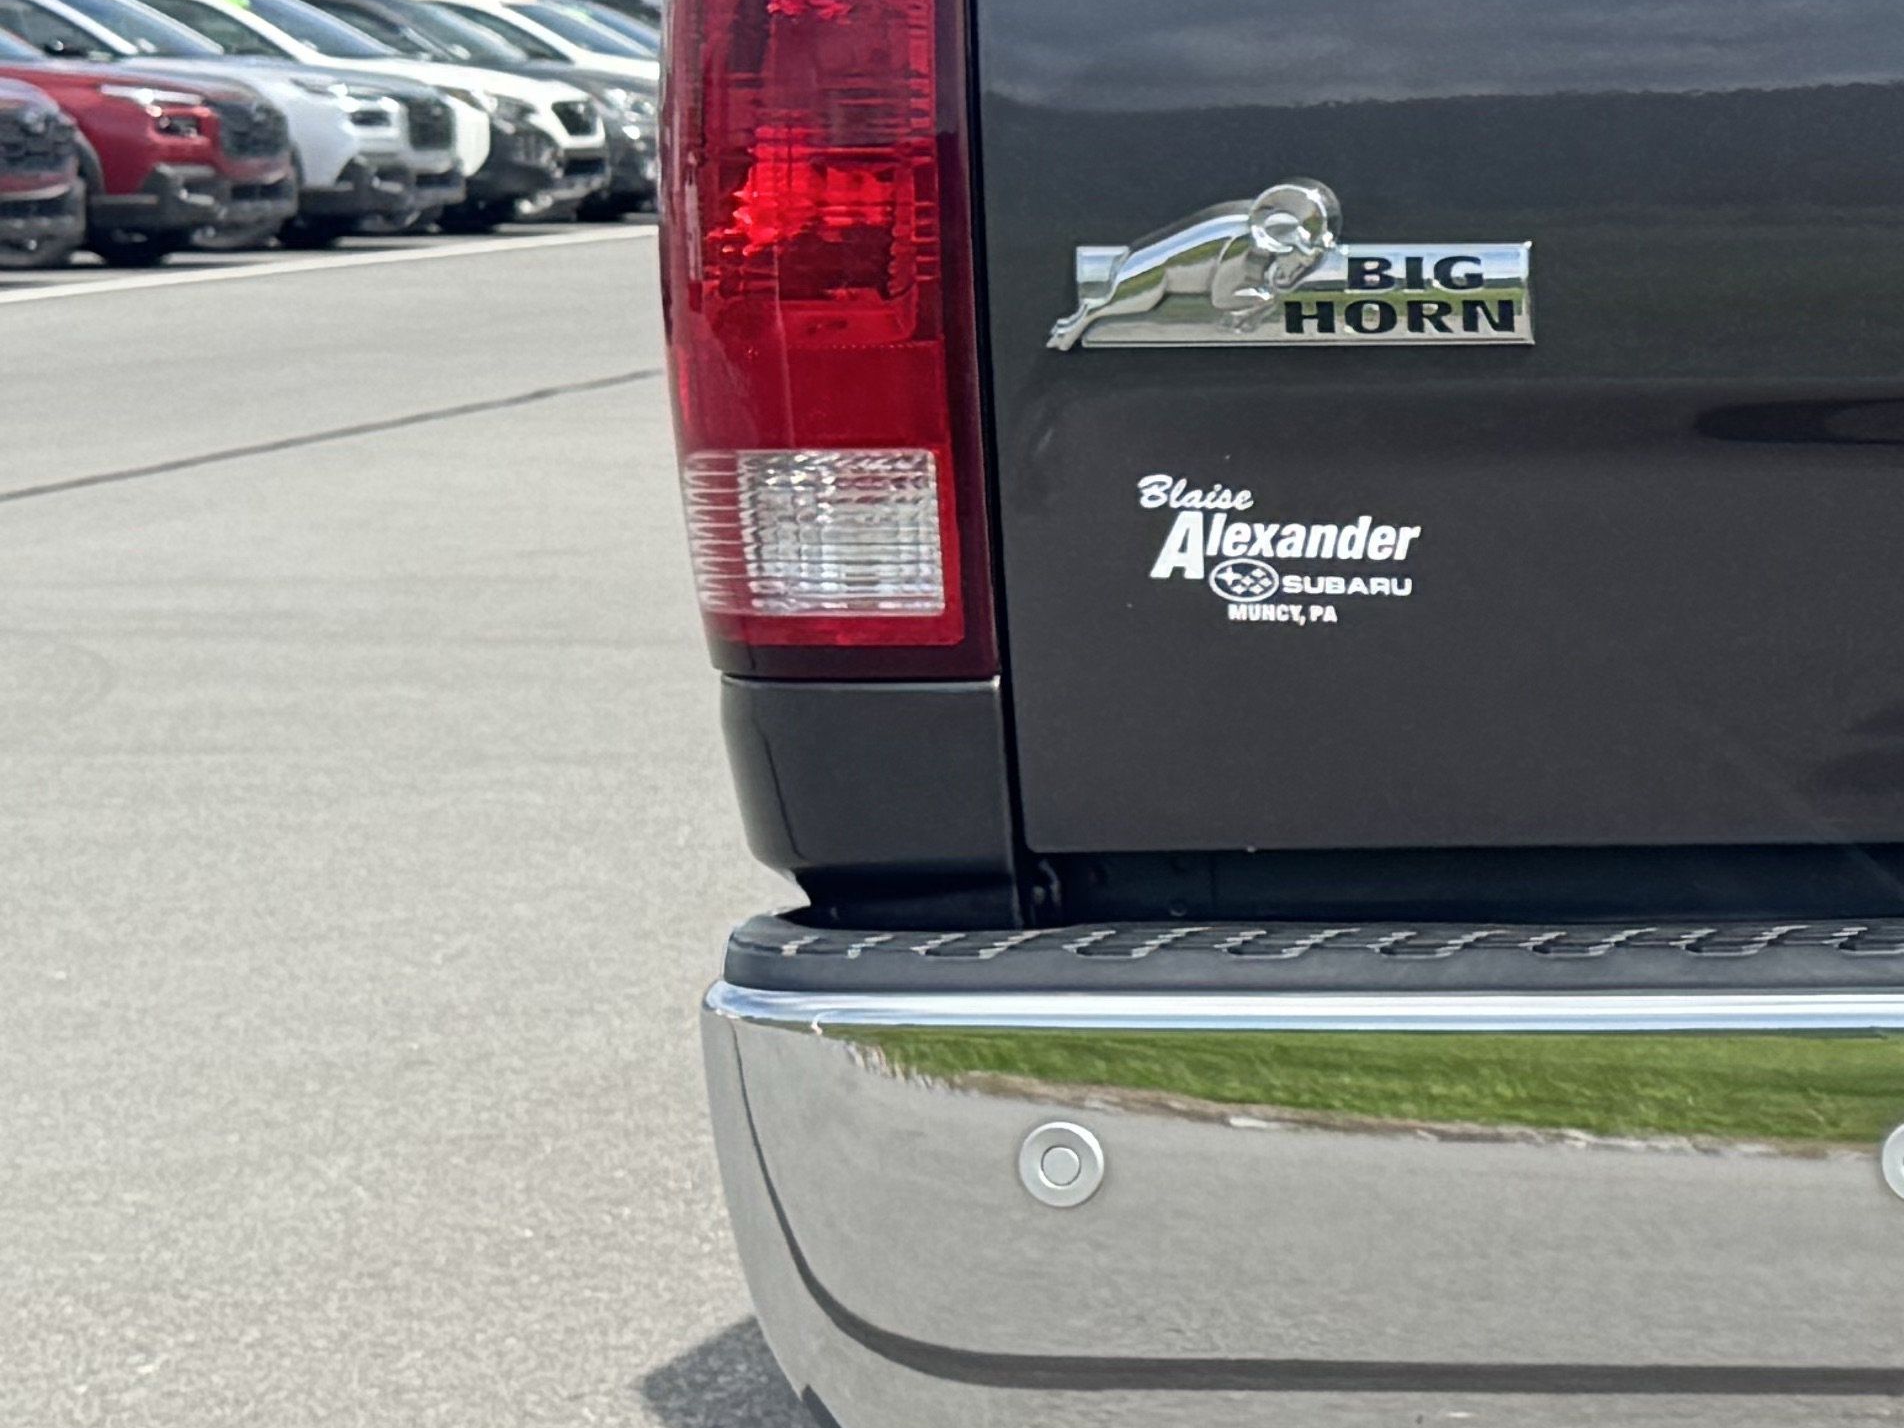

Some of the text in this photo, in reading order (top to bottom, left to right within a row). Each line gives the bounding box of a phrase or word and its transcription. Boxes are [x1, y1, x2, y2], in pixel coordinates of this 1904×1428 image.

[1346, 256, 1484, 291] BIG
[1285, 299, 1515, 334] HORN
[1137, 473, 1255, 511] Blaise
[1149, 510, 1422, 580] Alexander
[1281, 574, 1413, 597] SUBARU
[1227, 603, 1338, 626] MUNCY, PA
